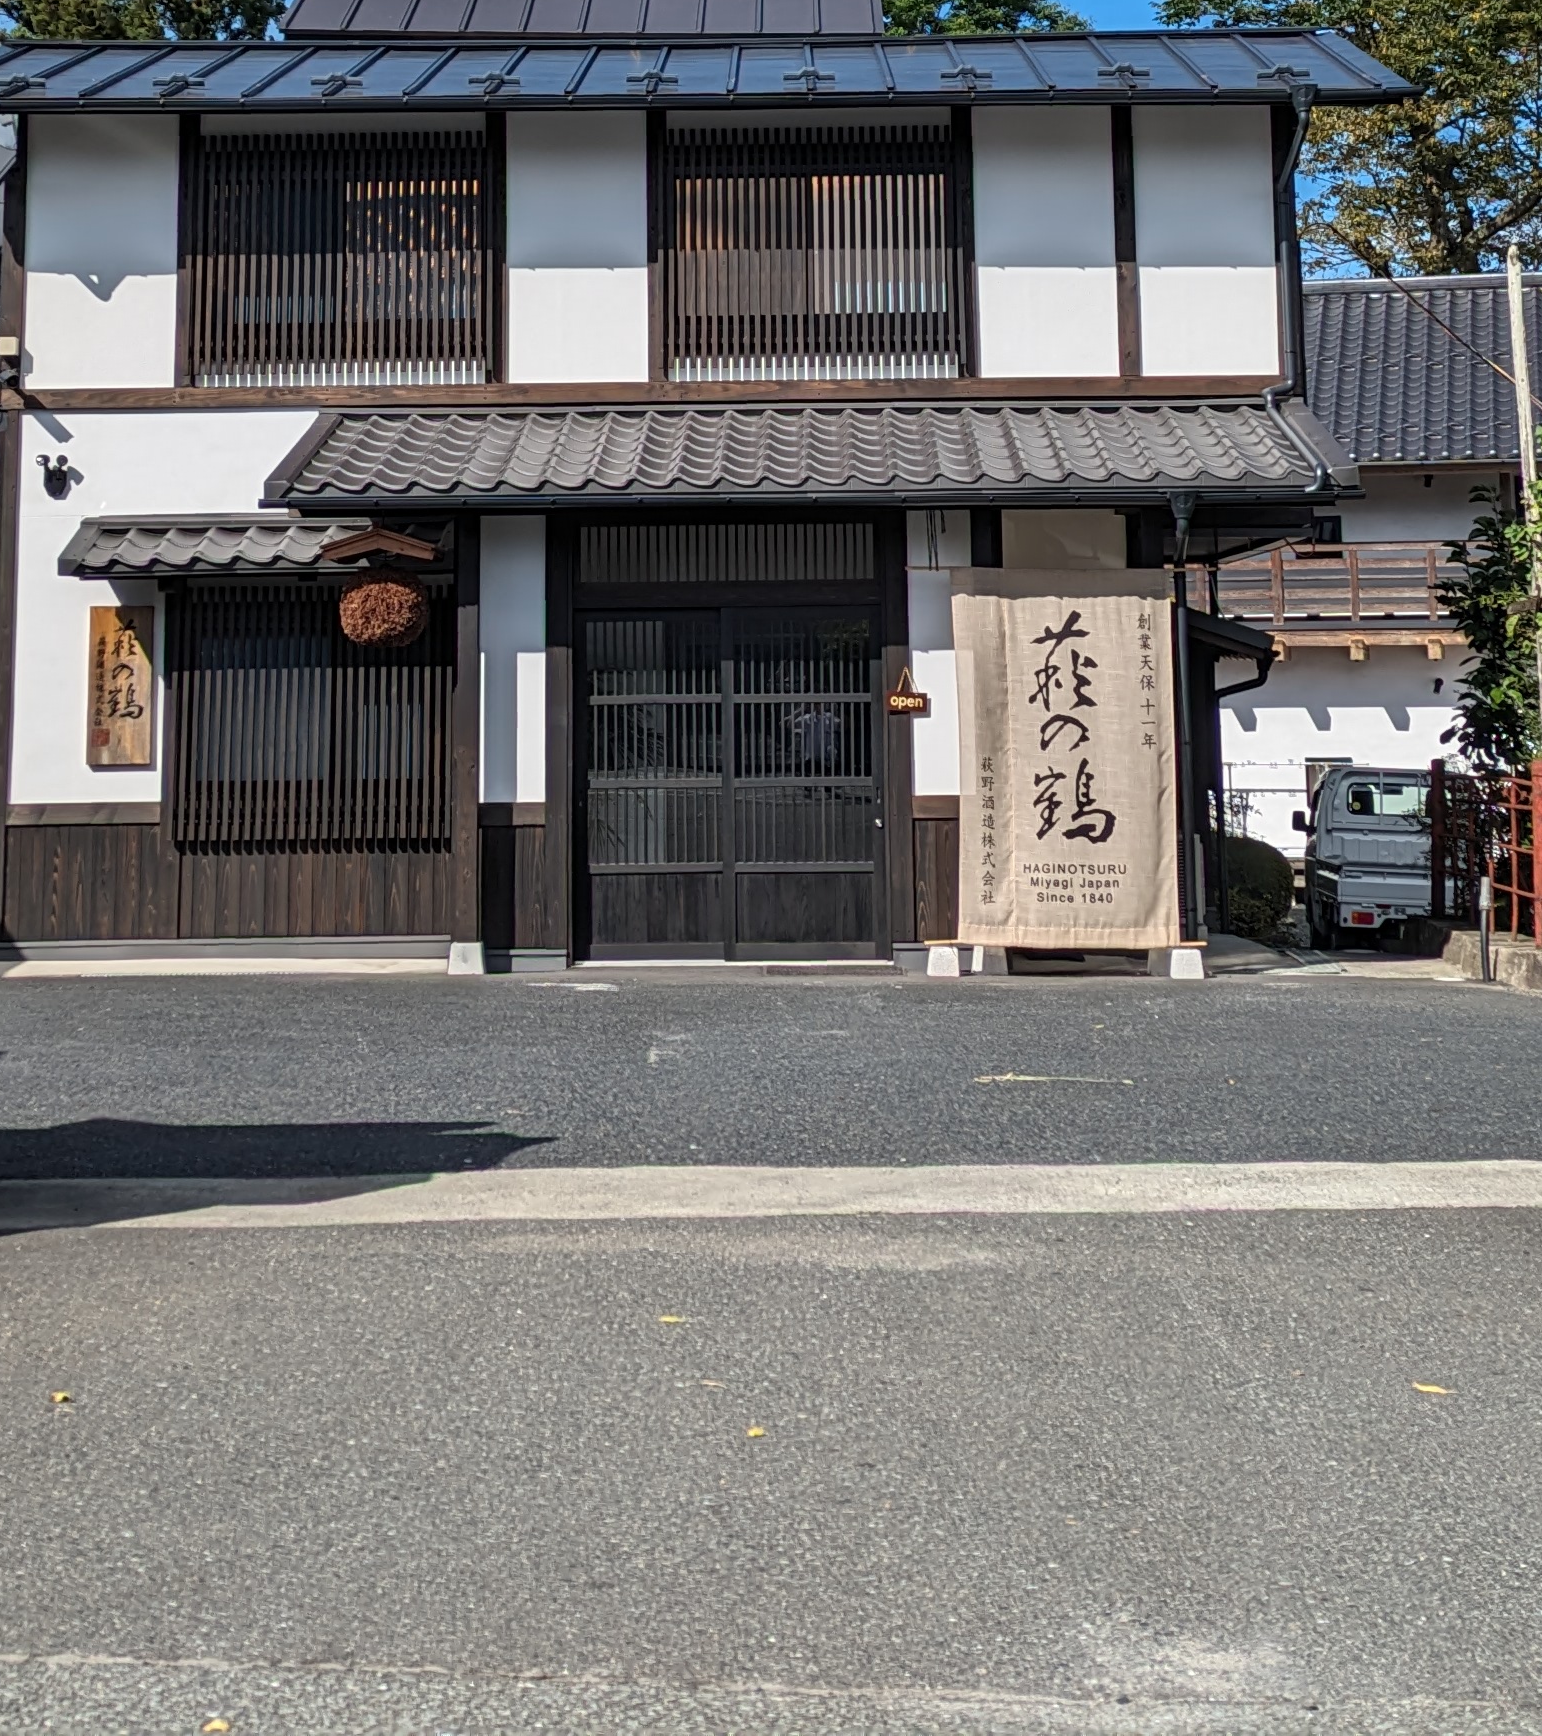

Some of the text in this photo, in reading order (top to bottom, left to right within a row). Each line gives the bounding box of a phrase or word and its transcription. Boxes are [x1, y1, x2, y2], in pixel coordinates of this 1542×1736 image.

[107, 619, 144, 720] 萩の鶴
[1136, 613, 1157, 750] 創業天保十一年
[890, 696, 923, 710] open
[1028, 610, 1117, 845] 萩の鶴
[980, 756, 996, 906] 萩野酒造株式会社
[1023, 863, 1127, 875] HAGINOTSURU
[1030, 877, 1120, 891] Miyagi Japan
[1036, 892, 1114, 904] Since 1840
